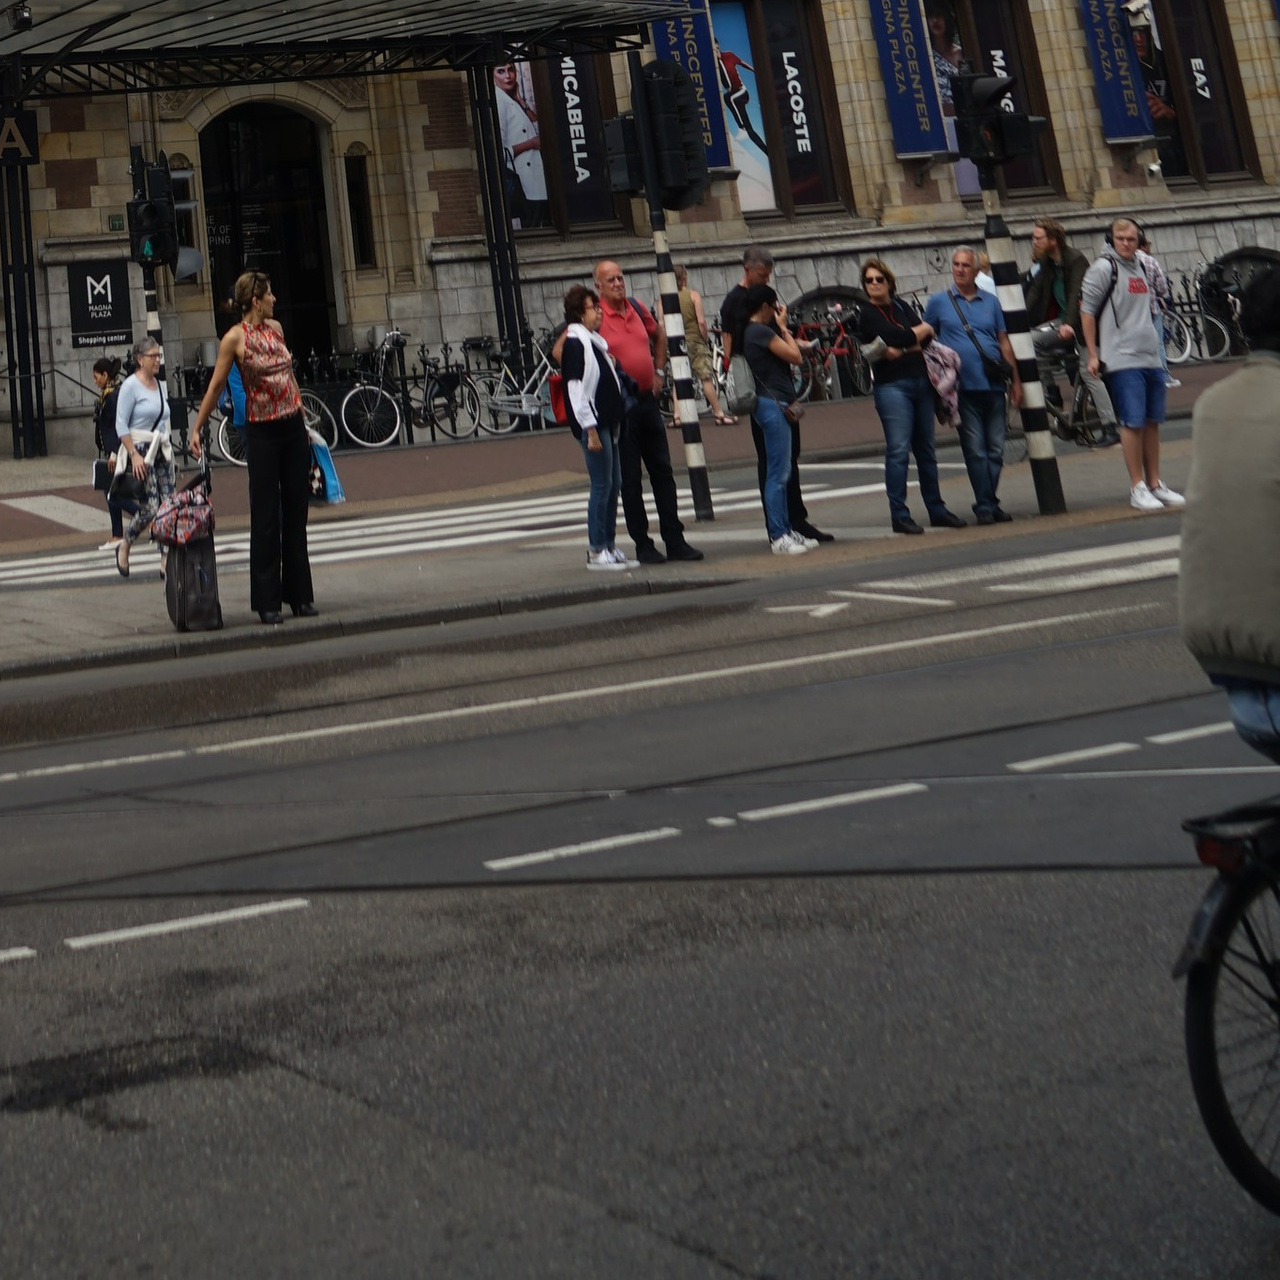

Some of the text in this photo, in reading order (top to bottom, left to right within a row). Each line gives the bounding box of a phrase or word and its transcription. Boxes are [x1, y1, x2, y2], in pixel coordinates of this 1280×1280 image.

[889, 38, 907, 95] PLAZA
[1093, 27, 1113, 81] PLAZA
[1190, 57, 1211, 99] EA7
[781, 51, 812, 153] LACOSTE
[88, 304, 113, 313] MAGNA
[90, 310, 112, 319] PLAZA
[78, 334, 127, 345] Shopping center
